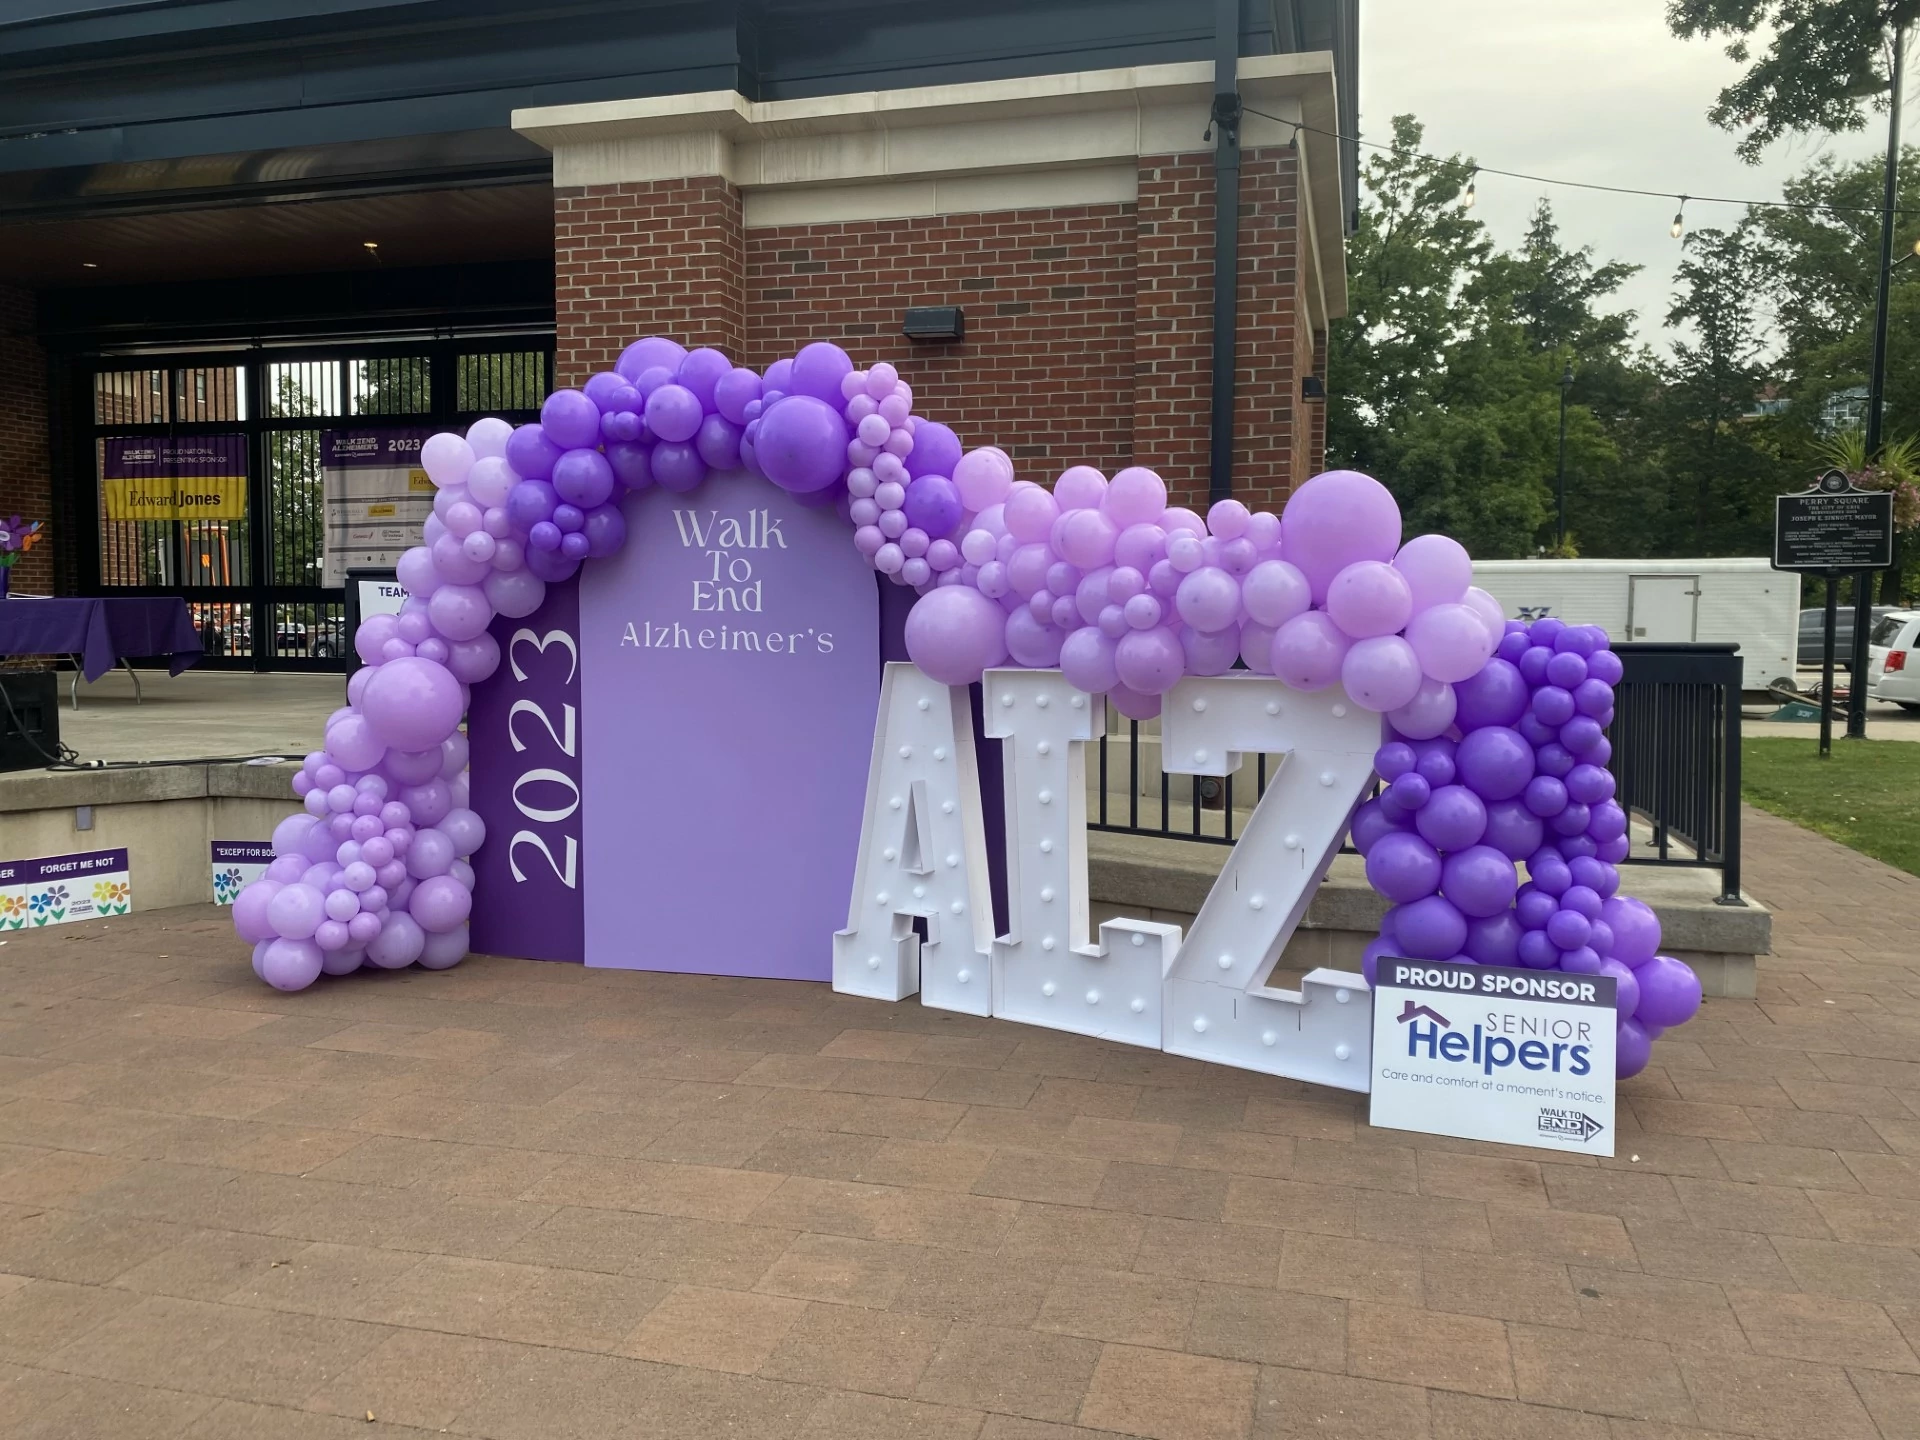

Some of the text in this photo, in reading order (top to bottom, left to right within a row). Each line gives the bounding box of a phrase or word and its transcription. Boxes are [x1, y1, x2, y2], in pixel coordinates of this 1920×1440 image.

[388, 438, 421, 452] 2023
[129, 490, 221, 507] Edward Jones
[1799, 497, 1870, 506] PERRY SQUARE
[672, 508, 788, 549] Walk
[705, 550, 752, 583] To
[378, 586, 410, 597] TEAM
[692, 580, 763, 612] End
[620, 621, 835, 654] Alzheimer's
[508, 628, 580, 889] 2023
[40, 857, 115, 875] FORGET ME NOT
[216, 847, 246, 856] "EXCEPT
[246, 848, 261, 857] FOR
[832, 661, 1373, 1094] ALZ
[1395, 966, 1596, 1002] PROUD SPONSOR
[1486, 1012, 1591, 1041] SENIOR
[1408, 1020, 1592, 1076] Helpers
[1381, 1068, 1606, 1104] Care and comfort at a moment's notice.
[1540, 1107, 1582, 1120] WALK TO
[1540, 1117, 1582, 1130] END
